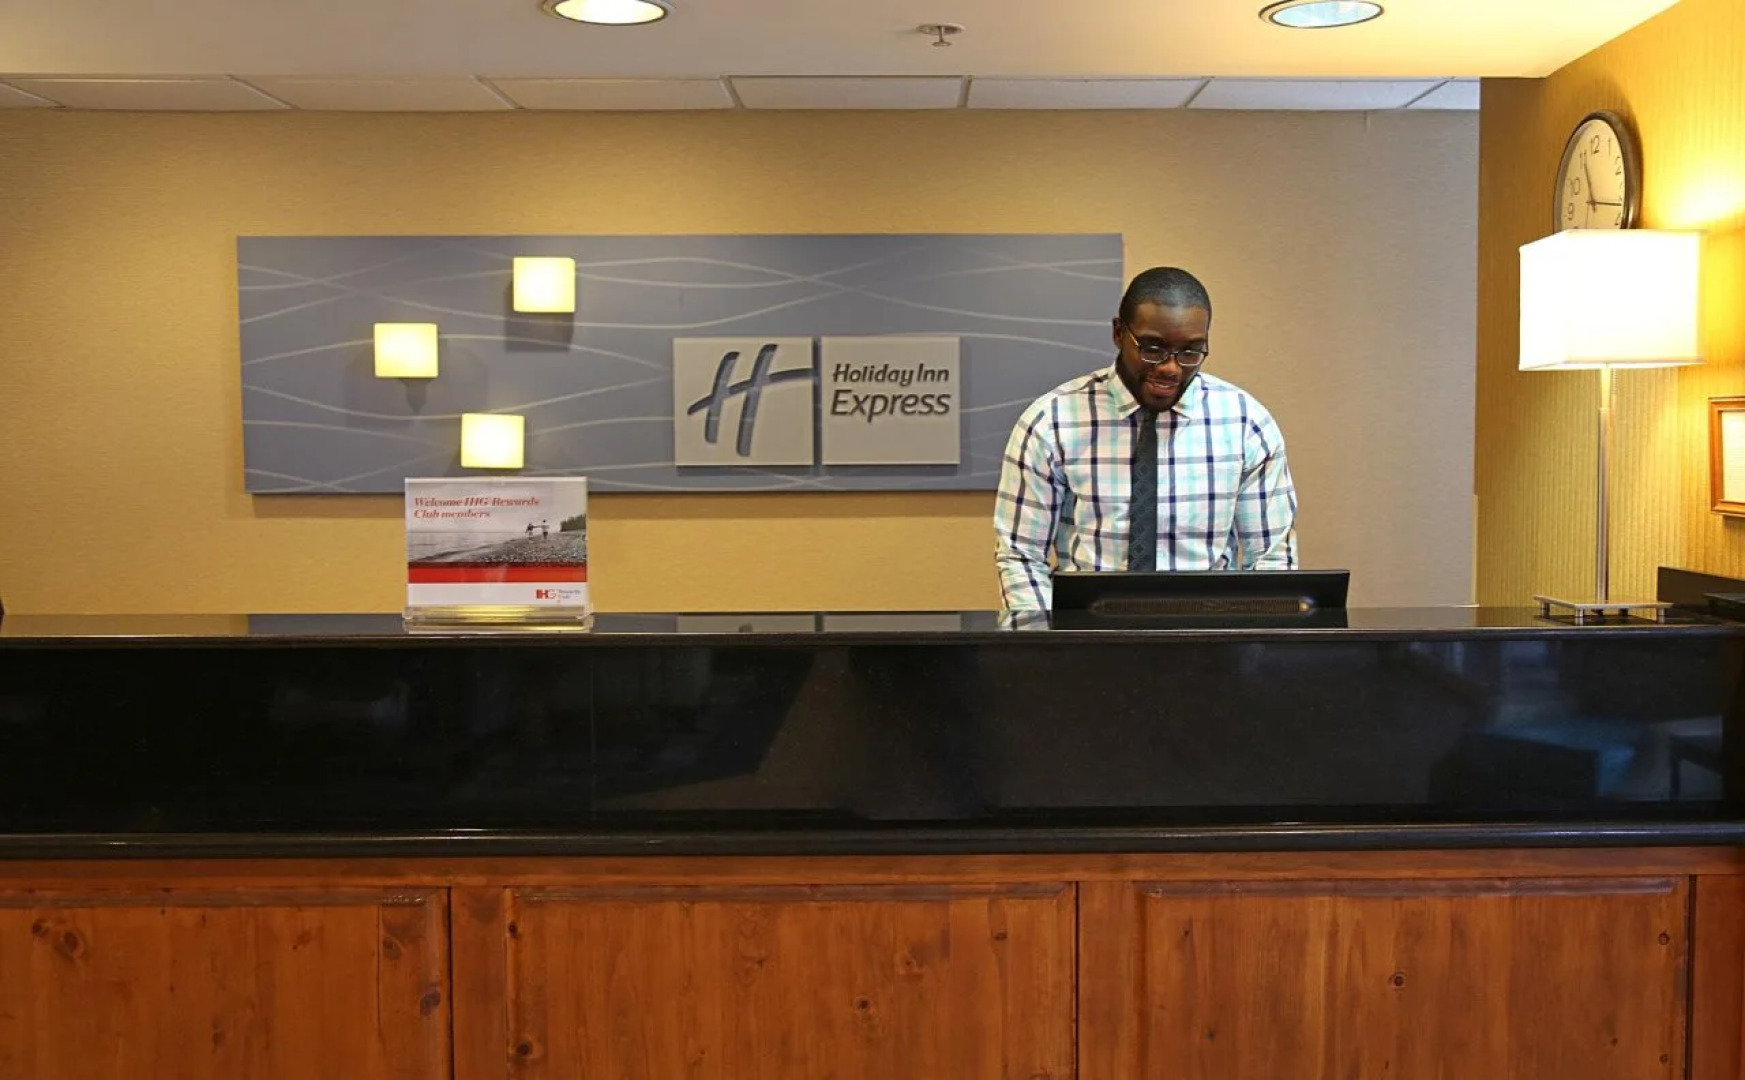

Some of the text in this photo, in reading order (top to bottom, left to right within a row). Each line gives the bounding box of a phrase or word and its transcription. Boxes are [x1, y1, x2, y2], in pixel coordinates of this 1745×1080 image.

[1590, 135, 1600, 156] 12
[1567, 202, 1575, 221] 9
[832, 363, 950, 387] Holiday Inn
[830, 389, 952, 423] Express
[414, 496, 540, 507] Welcome IHG Rewards
[414, 509, 491, 519] Club members
[536, 589, 557, 600] IHG
